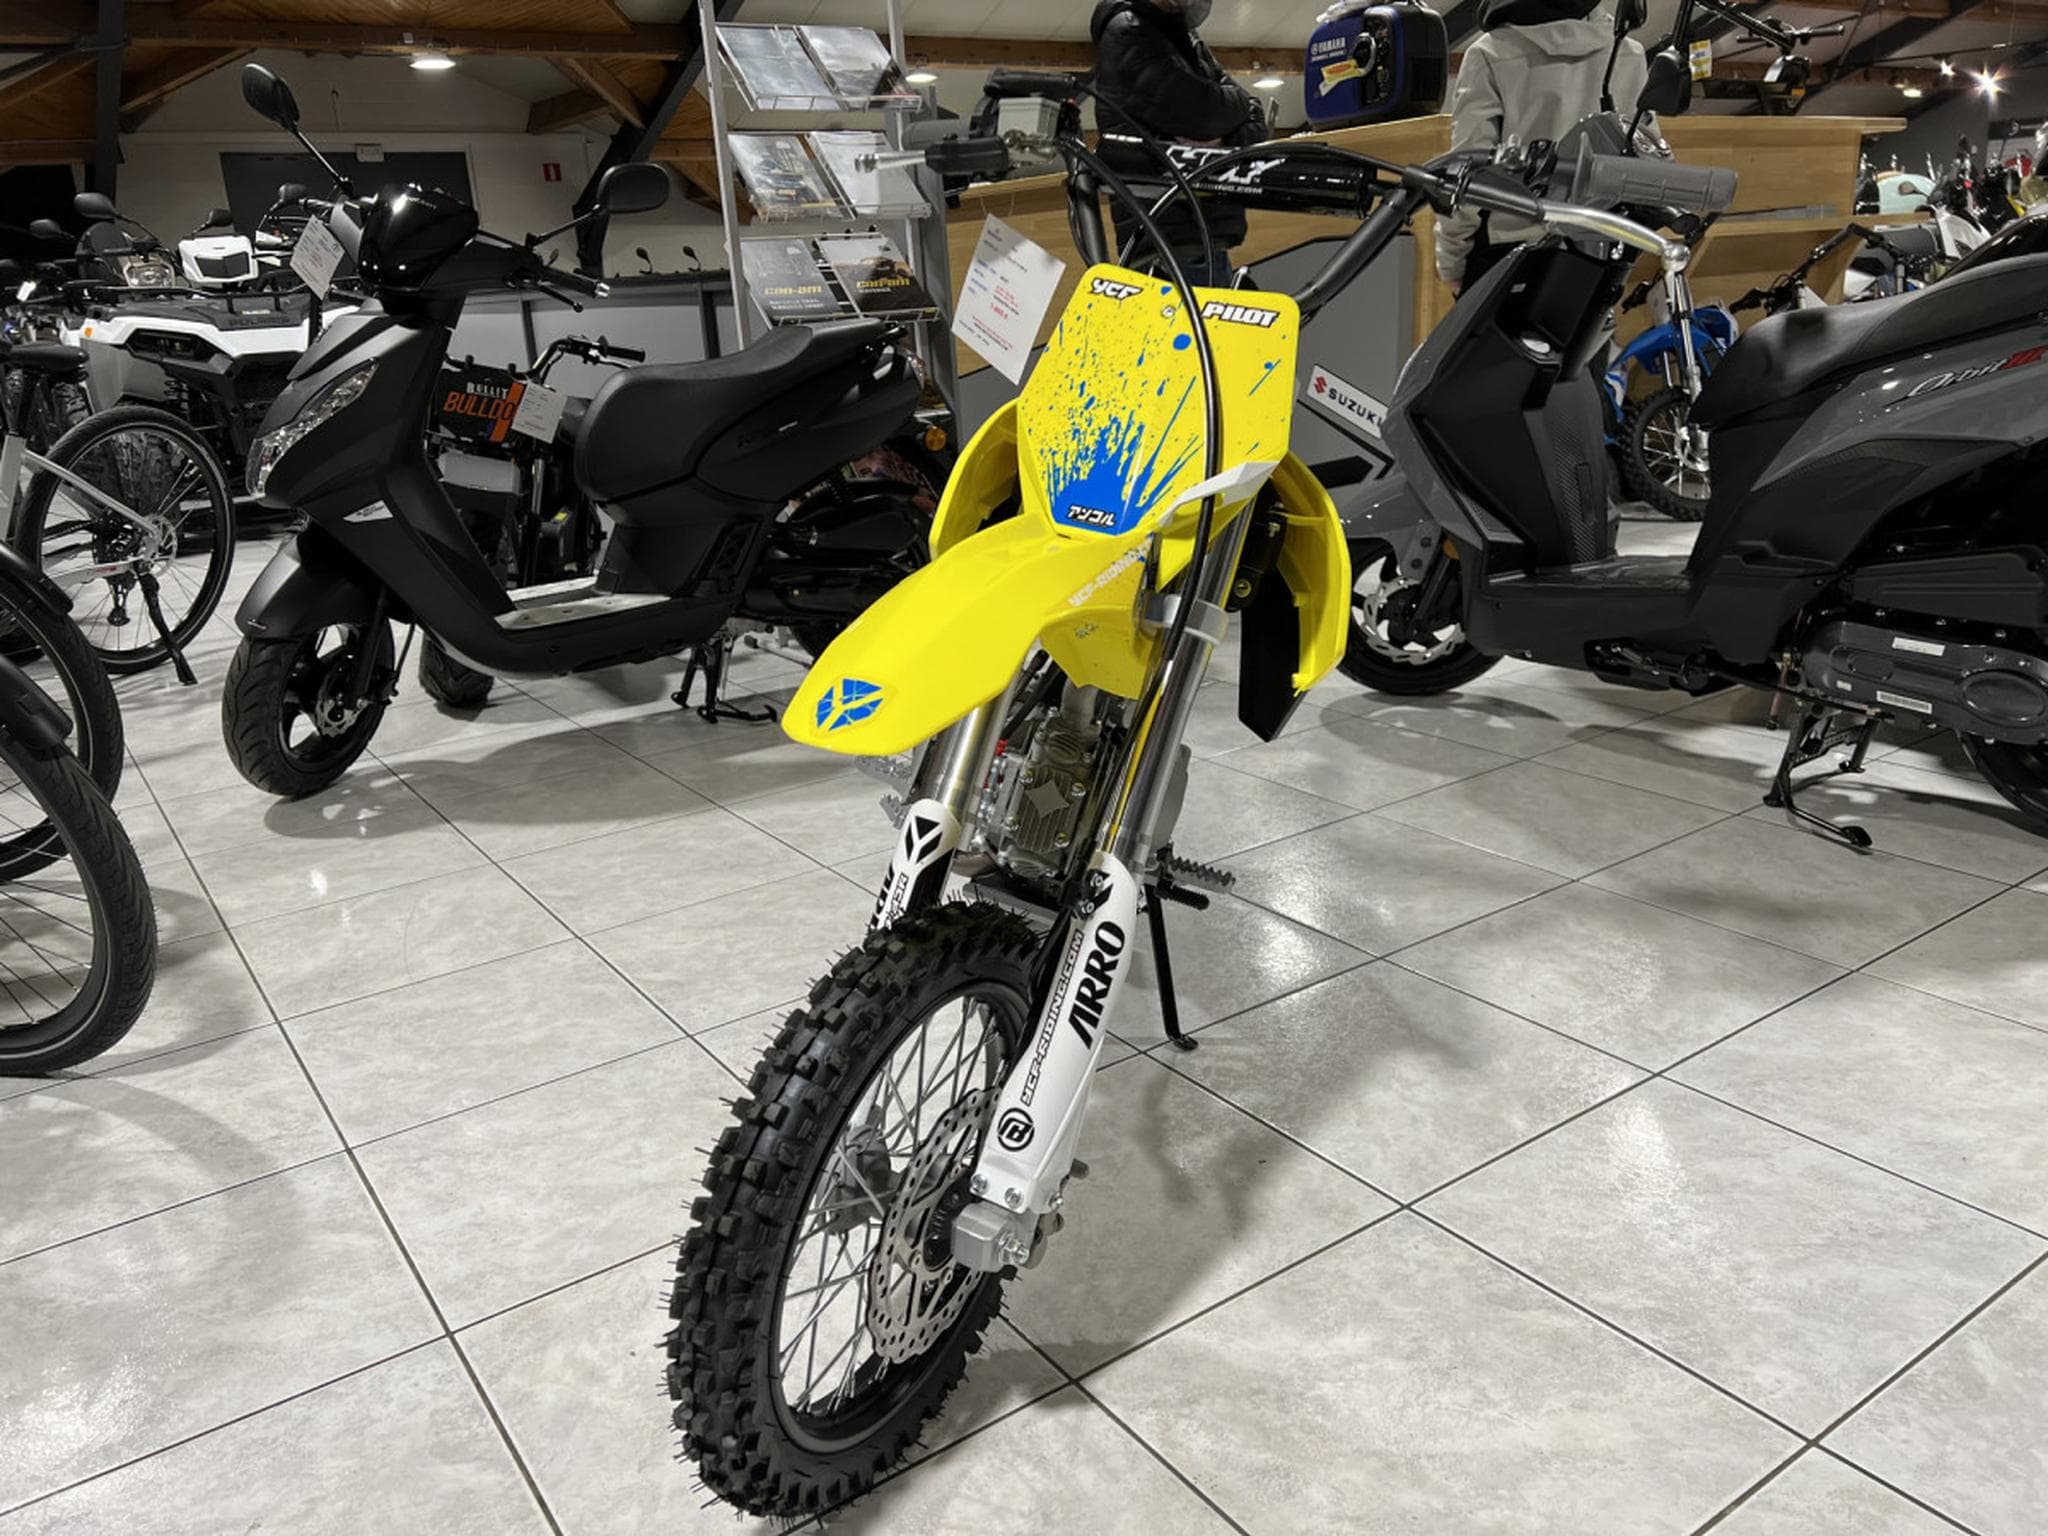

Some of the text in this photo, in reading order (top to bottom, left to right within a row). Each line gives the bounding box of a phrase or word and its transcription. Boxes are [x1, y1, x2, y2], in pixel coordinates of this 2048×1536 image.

[1319, 37, 1346, 53] YAMAHA
[1091, 278, 1142, 300] YCF
[1201, 301, 1279, 327] PILOT
[443, 391, 518, 420] BULLDO
[1328, 388, 1383, 427] SUZUKI
[1021, 928, 1085, 1107] YCF-RIDING.COM
